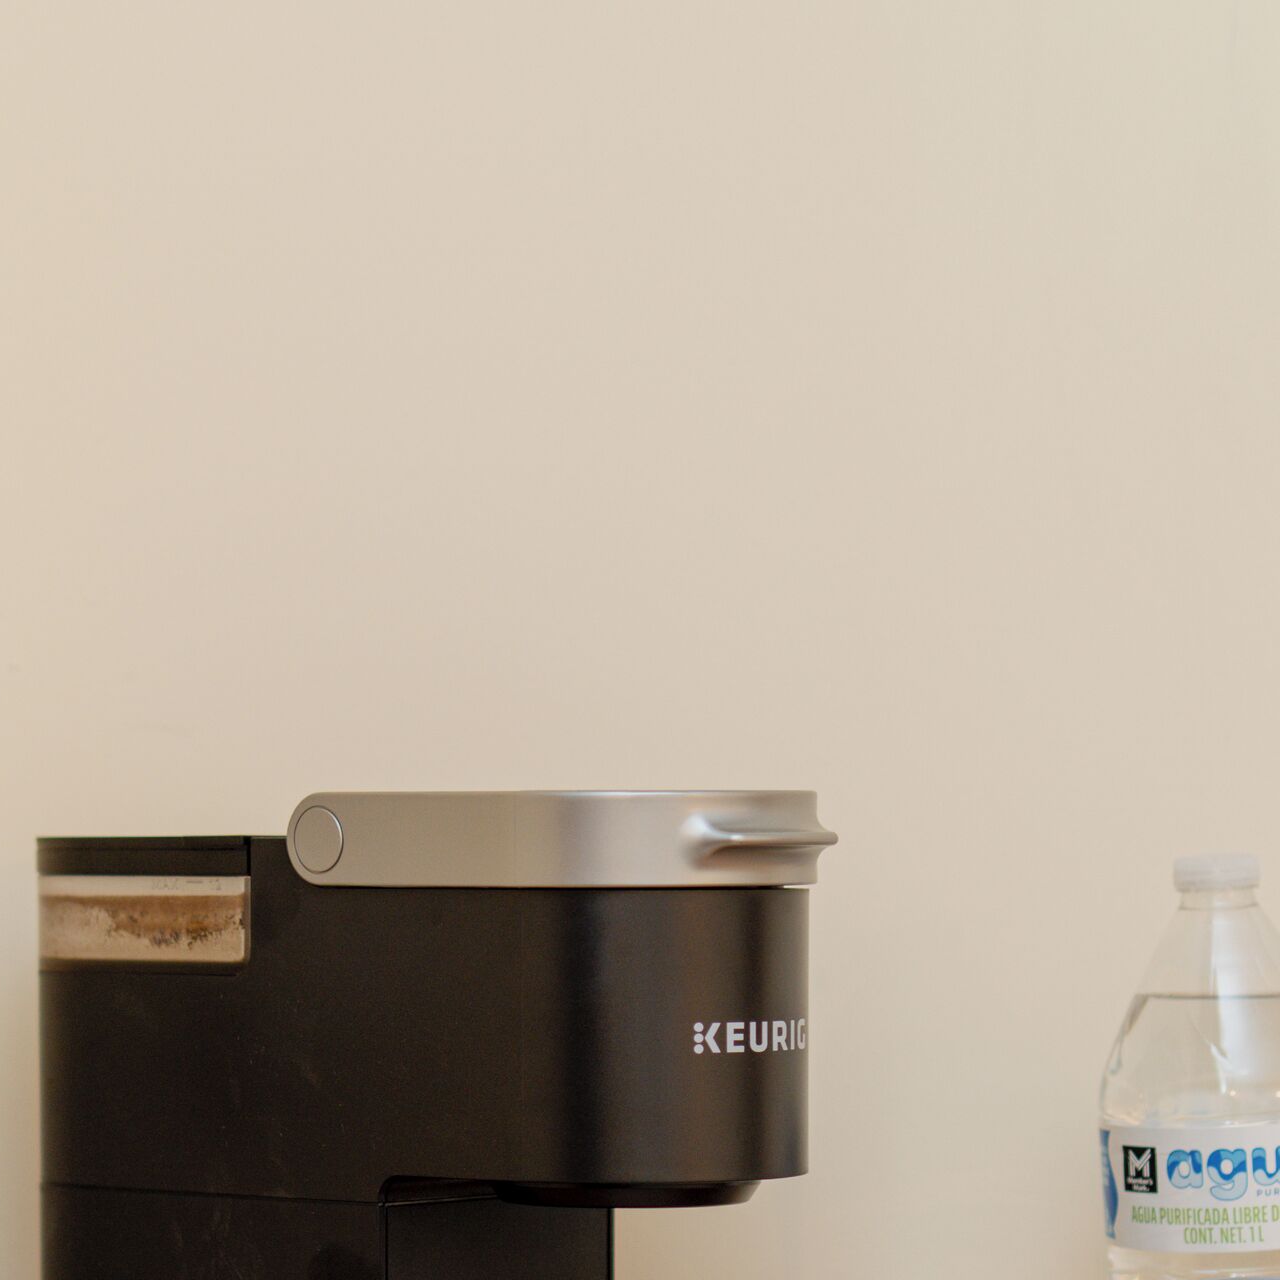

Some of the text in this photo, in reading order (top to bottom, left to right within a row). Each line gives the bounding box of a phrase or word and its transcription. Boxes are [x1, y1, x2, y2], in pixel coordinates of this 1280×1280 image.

[693, 1018, 806, 1055] KEURIG
[1131, 1205, 1157, 1224] AGUA
[1160, 1206, 1230, 1225] PURIFICADA
[1233, 1205, 1268, 1225] LIBRE
[1184, 1227, 1218, 1244] CONT.
[1220, 1226, 1246, 1244] NET.
